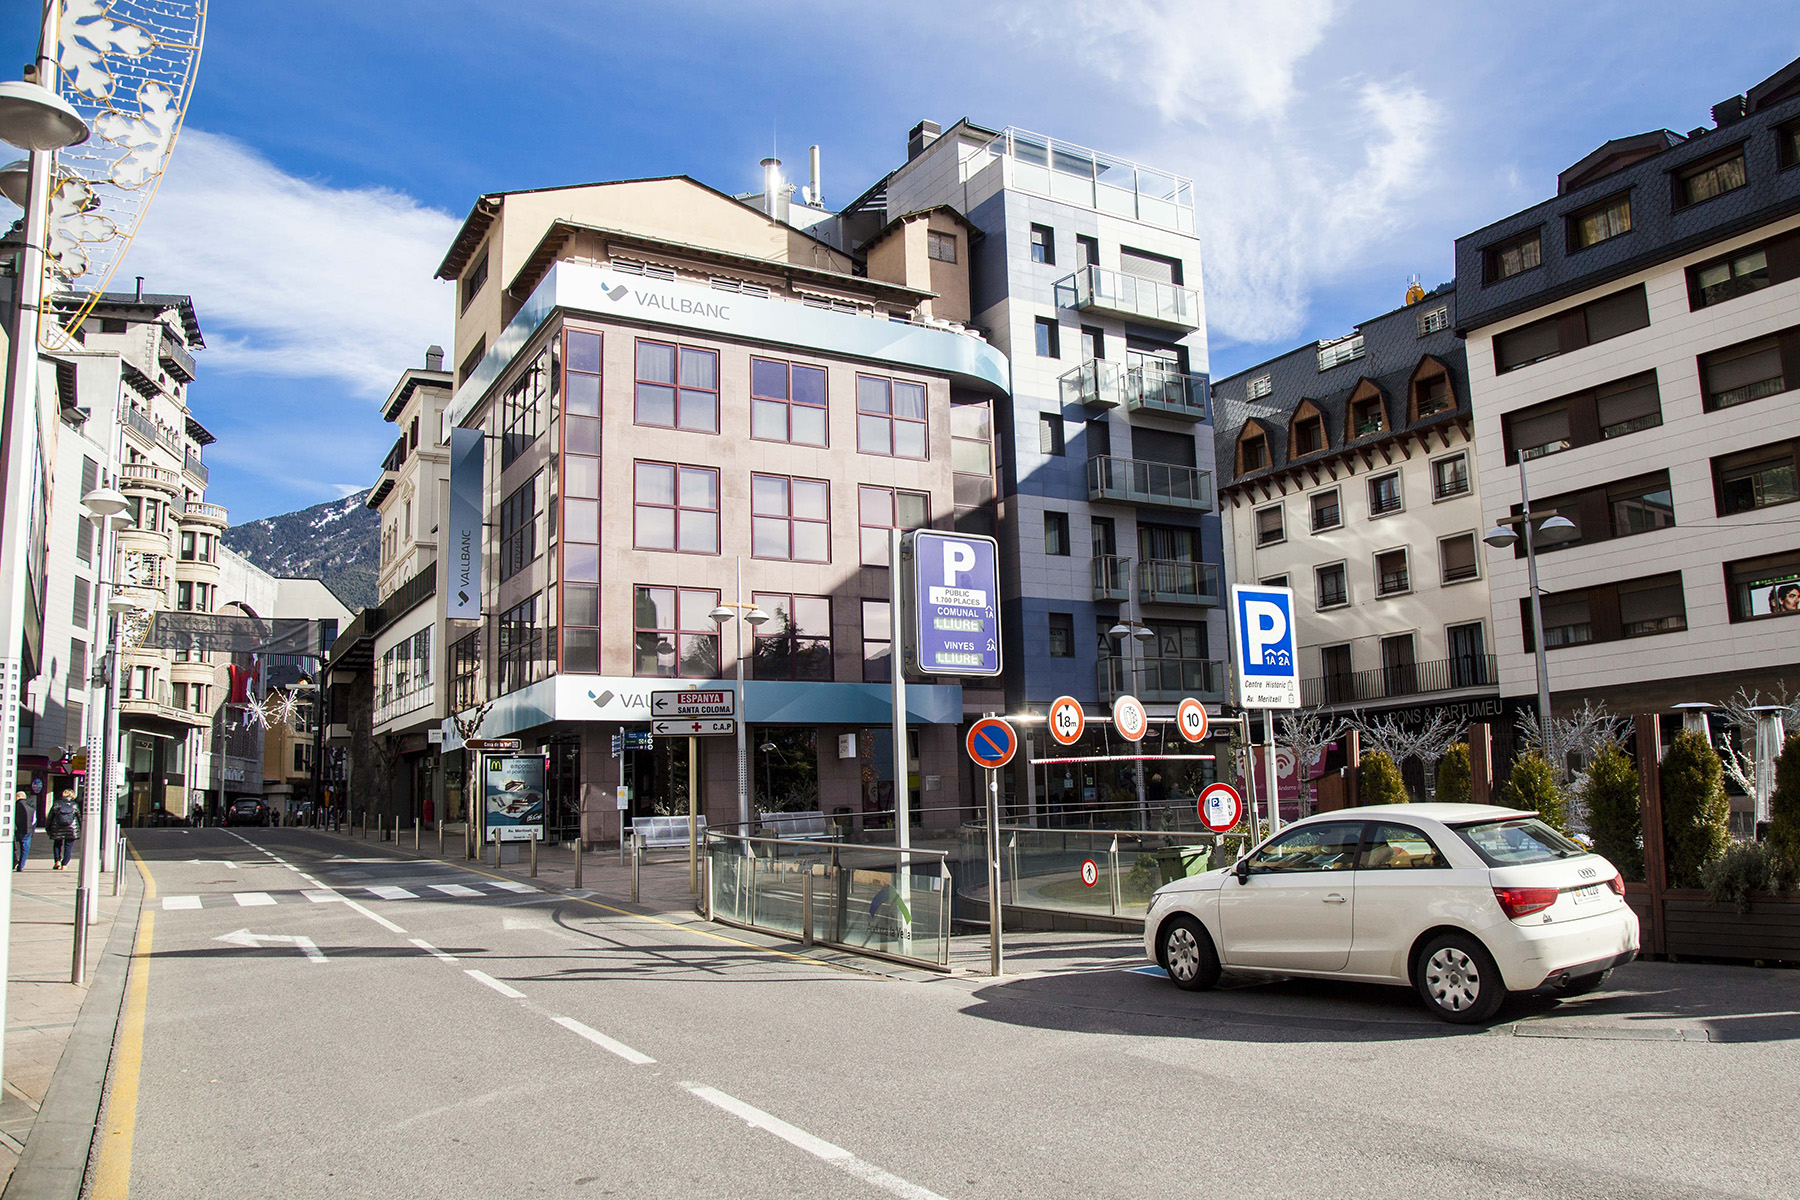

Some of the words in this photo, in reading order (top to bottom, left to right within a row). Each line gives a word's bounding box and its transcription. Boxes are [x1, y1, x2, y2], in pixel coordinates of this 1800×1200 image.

[634, 290, 730, 320] VALLBANC
[460, 529, 472, 588] VALLBANC
[943, 540, 976, 587] P
[935, 596, 952, 604] 1.700
[953, 597, 980, 606] PLACES
[937, 606, 979, 618] COMUNAL
[985, 610, 994, 619] 1A
[936, 617, 980, 630] LLIURE
[1245, 600, 1287, 665] P
[944, 641, 975, 651] VINYES
[986, 643, 996, 652] 2A
[937, 652, 979, 666] LLIURE
[1266, 656, 1276, 665] 1A
[1278, 656, 1290, 666] 2A
[1245, 680, 1262, 688] Centre
[680, 694, 720, 703] ESPANYA
[1246, 695, 1254, 703] Av.
[1258, 695, 1282, 703] Meritxell
[678, 706, 699, 714] SANTA
[701, 705, 731, 714] COLOMA
[1391, 709, 1421, 724] PONS
[1424, 708, 1432, 722] &
[1186, 713, 1200, 727] 10
[712, 723, 732, 731] C.A.P
